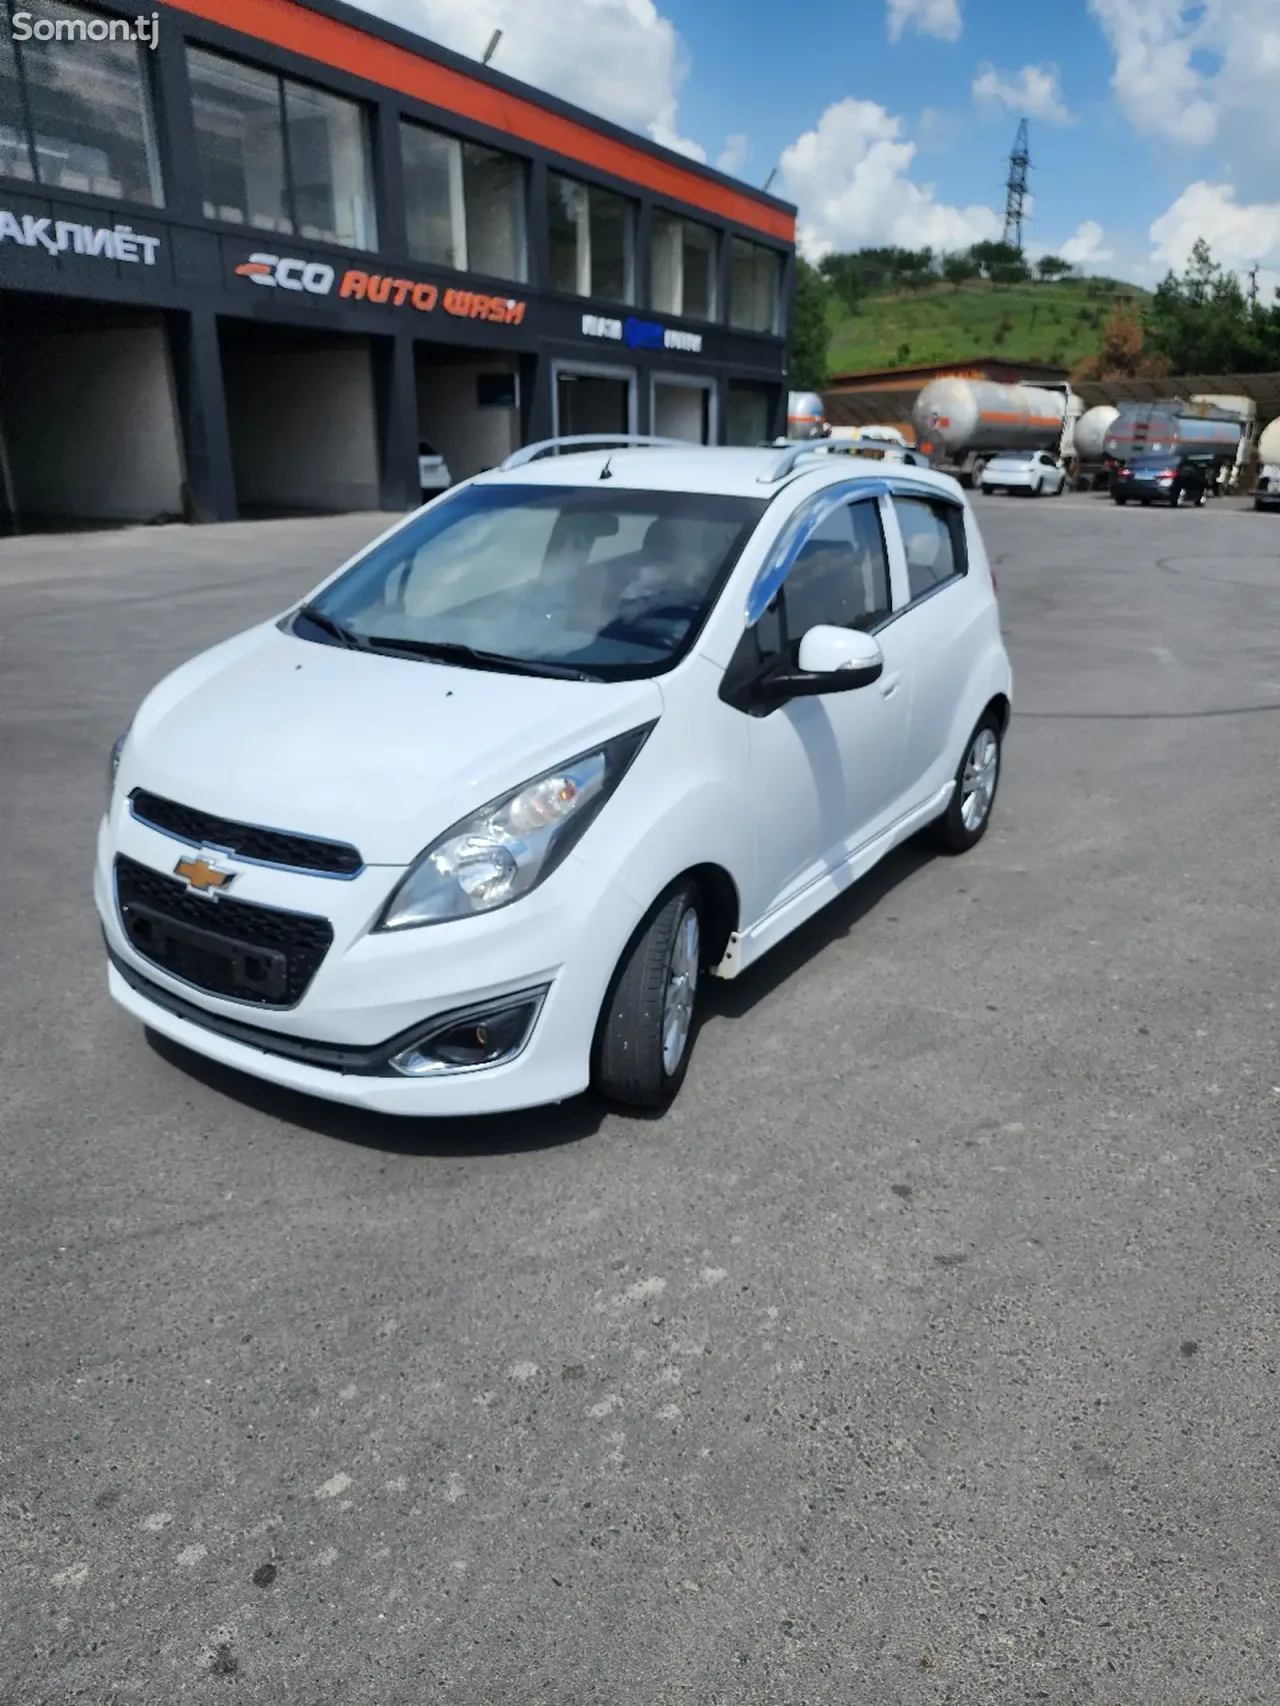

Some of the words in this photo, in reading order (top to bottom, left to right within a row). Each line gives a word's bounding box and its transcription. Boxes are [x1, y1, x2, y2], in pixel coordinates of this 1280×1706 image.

[235, 253, 335, 295] ECO
[339, 270, 438, 312] AUTO
[443, 288, 526, 325] WASH
